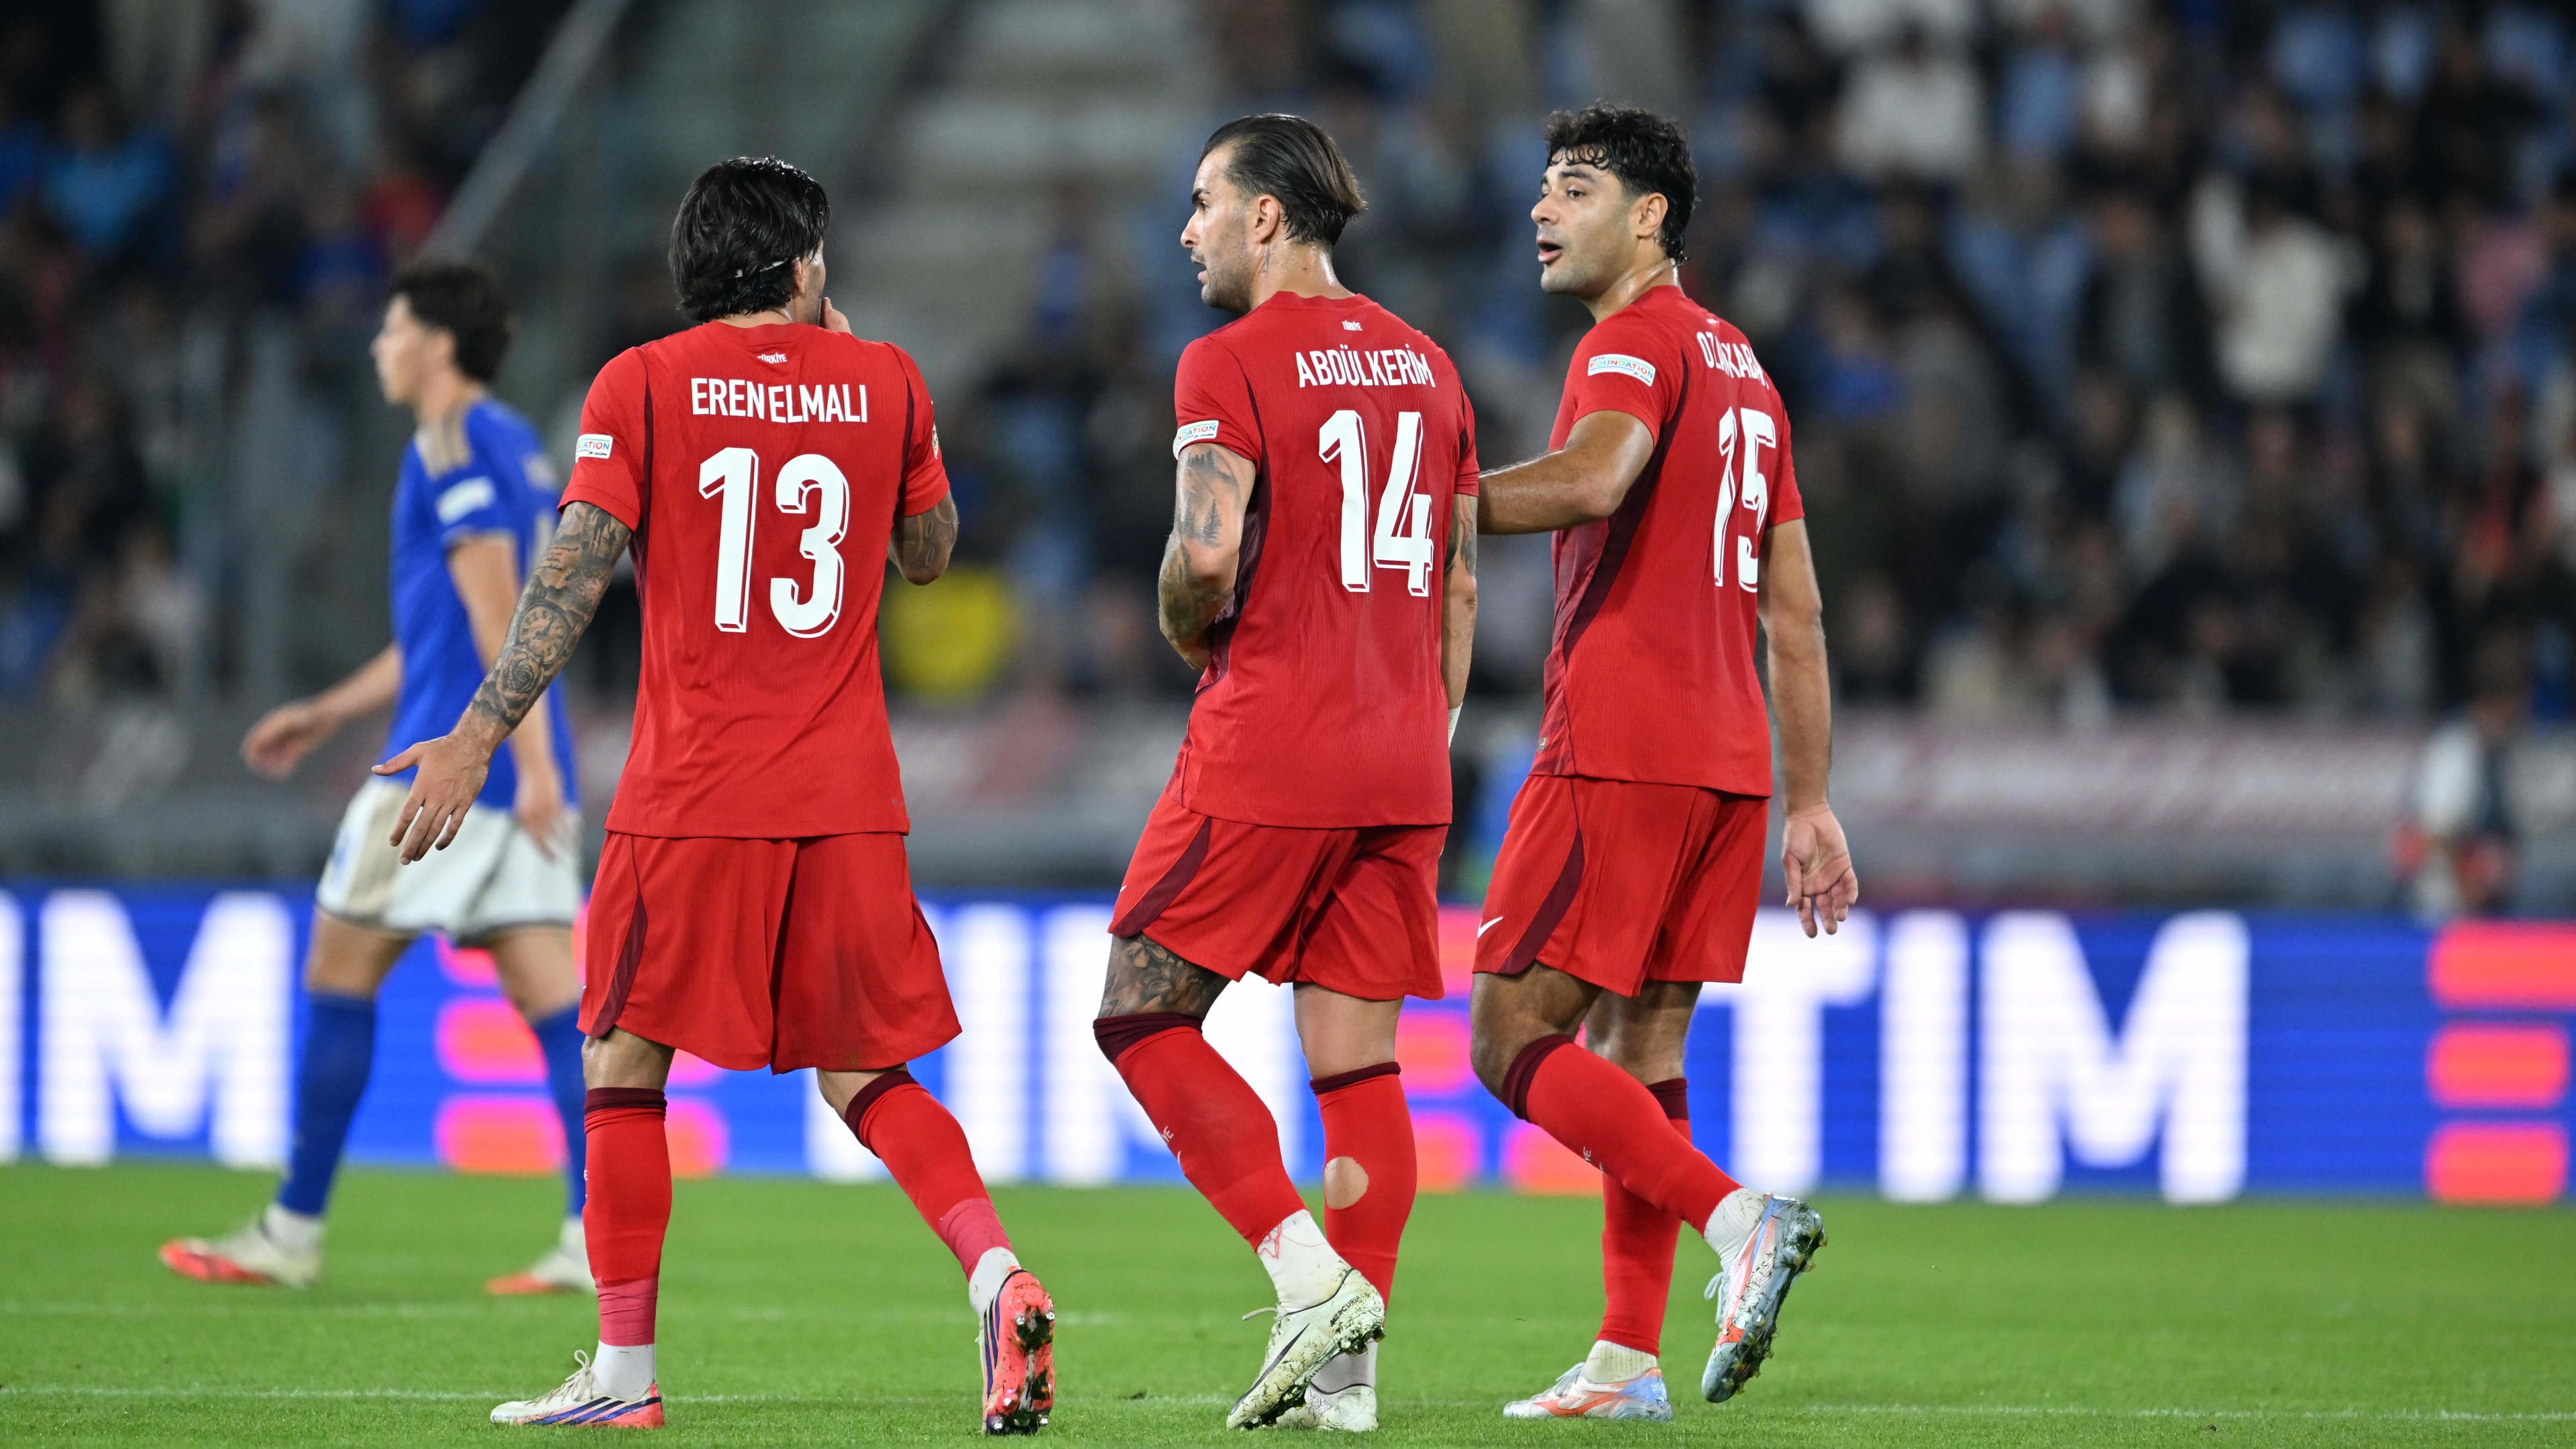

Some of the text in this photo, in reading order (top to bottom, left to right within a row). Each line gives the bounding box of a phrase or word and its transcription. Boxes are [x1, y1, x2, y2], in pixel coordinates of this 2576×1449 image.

[1295, 343, 1436, 388] ABDÜLKERİM
[1590, 360, 1654, 378] FOUNDATION
[698, 447, 850, 638] 13
[1319, 410, 1434, 596] 14
[1714, 406, 1776, 593] 15
[1699, 907, 2251, 1205] TIM
